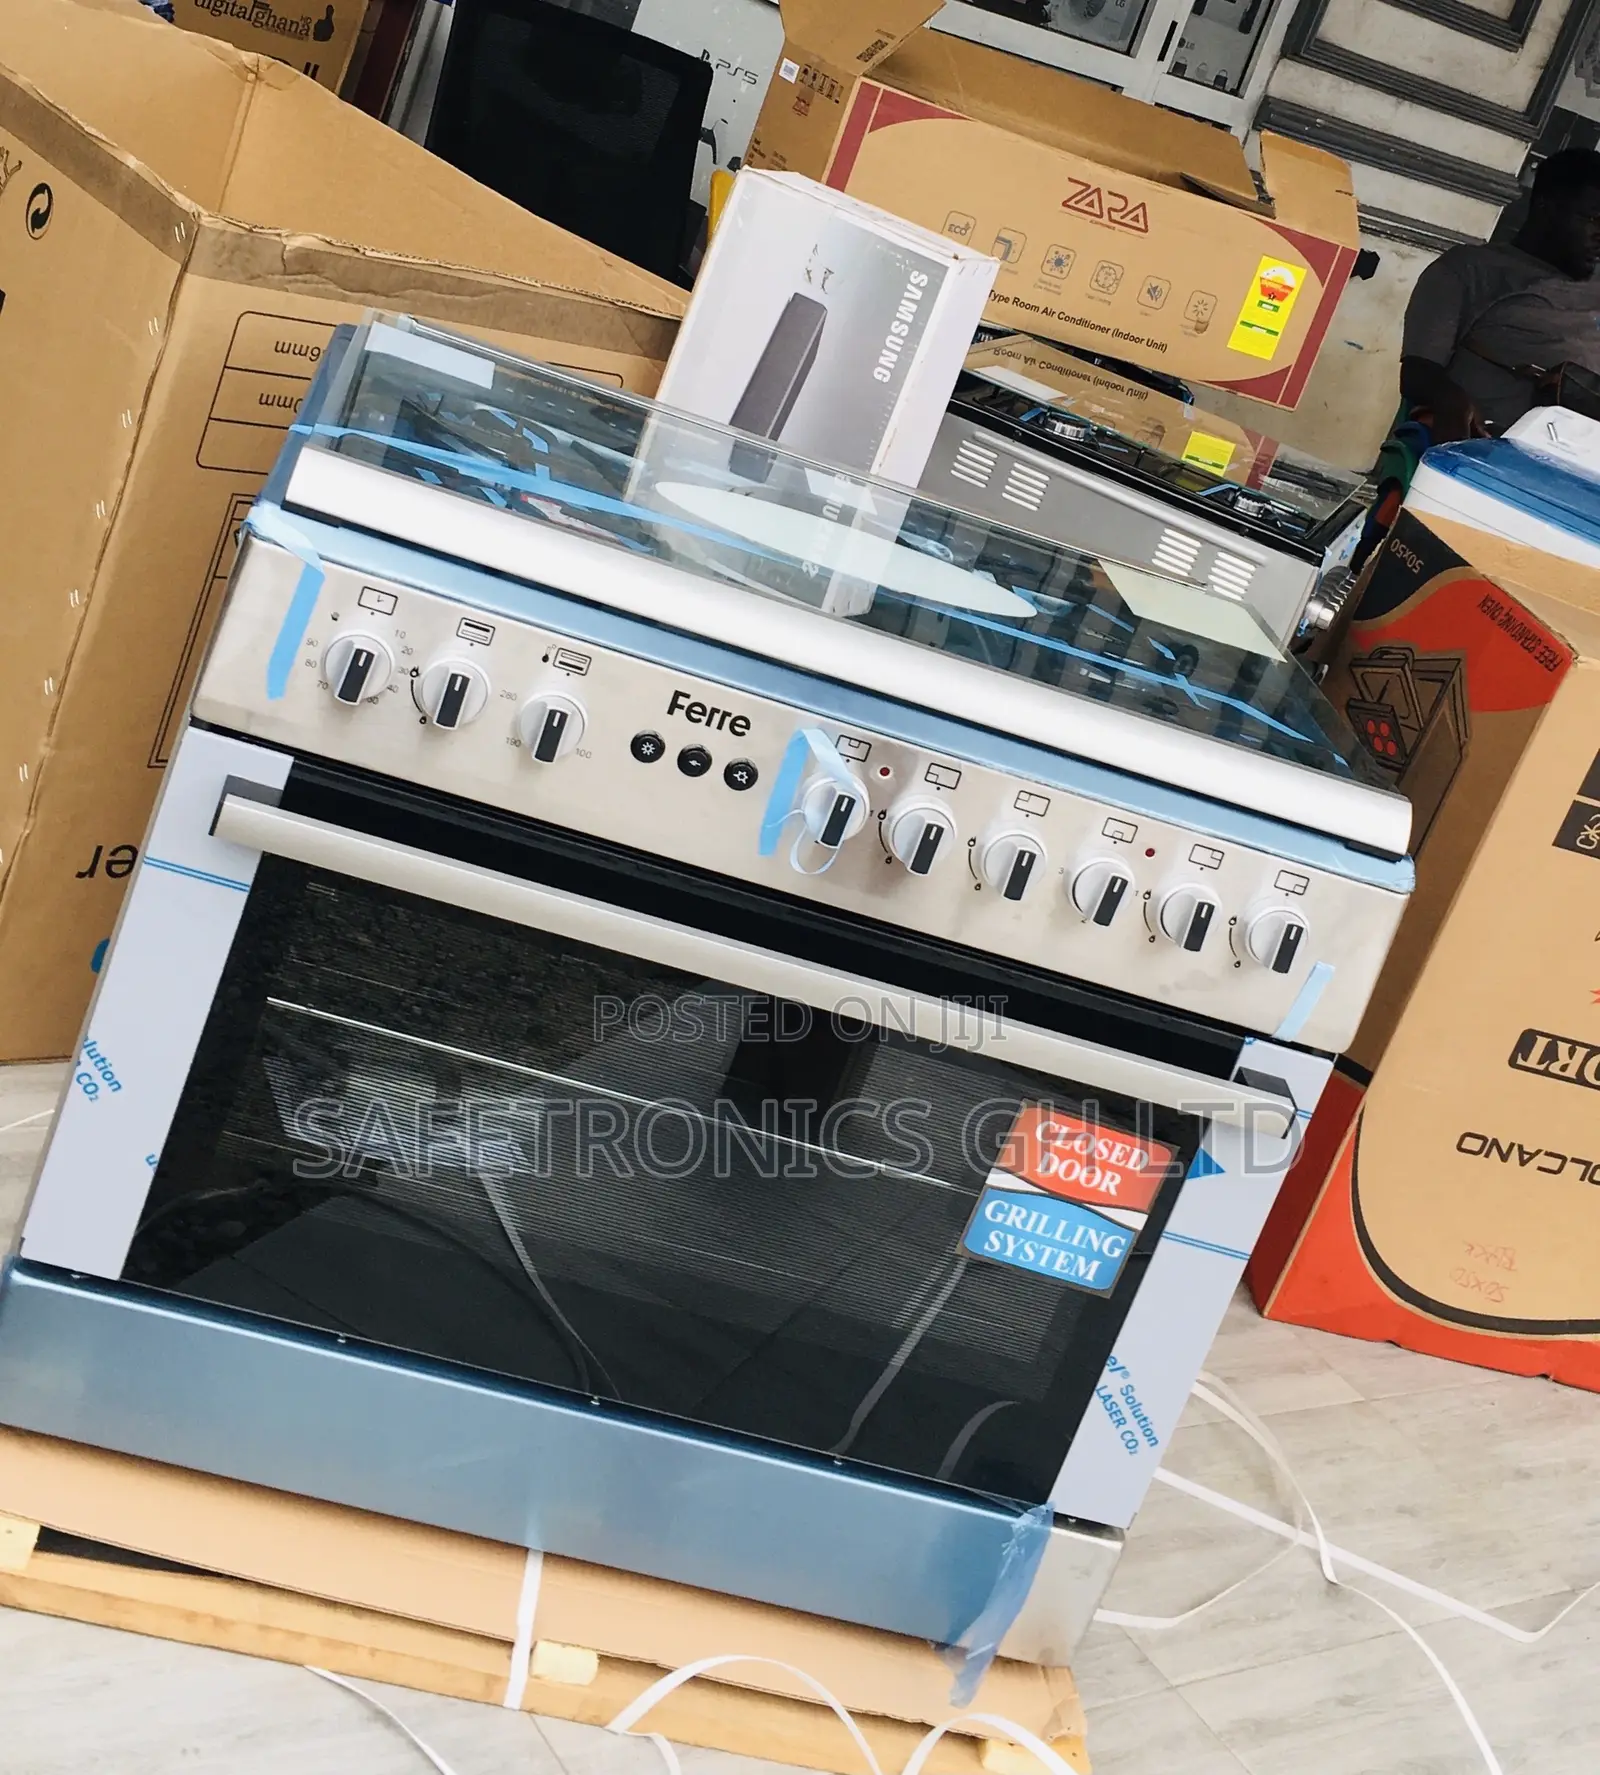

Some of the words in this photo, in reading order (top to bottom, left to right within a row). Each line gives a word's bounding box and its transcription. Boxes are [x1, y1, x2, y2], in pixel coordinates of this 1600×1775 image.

[716, 58, 759, 85] PS5
[1062, 177, 1149, 233] ZARA
[947, 223, 968, 236] ECO
[873, 270, 928, 383] SAMSUNG
[989, 289, 1010, 304] Type
[1012, 297, 1040, 313] Room
[1041, 306, 1056, 318] Air
[1057, 310, 1115, 335] Conditioner
[1111, 327, 1144, 345] (Indoor
[1145, 338, 1168, 353] Unit)
[1390, 538, 1424, 574] 50x50
[306, 638, 318, 647] 90
[394, 629, 406, 639] 10
[401, 645, 414, 656] 20
[305, 659, 317, 668] 80
[1534, 645, 1563, 672] FREE
[317, 679, 329, 690] 70
[666, 689, 752, 737] Ferre
[575, 747, 593, 760] 100
[83, 1036, 122, 1093] lution
[1035, 1120, 1149, 1172] CLOSED
[1036, 1151, 1122, 1197] DOOR
[984, 1199, 1127, 1259] GRILLING
[983, 1229, 1102, 1283] SYSTEM
[1095, 1384, 1127, 1429] LASER
[1120, 1383, 1159, 1447] Solution
